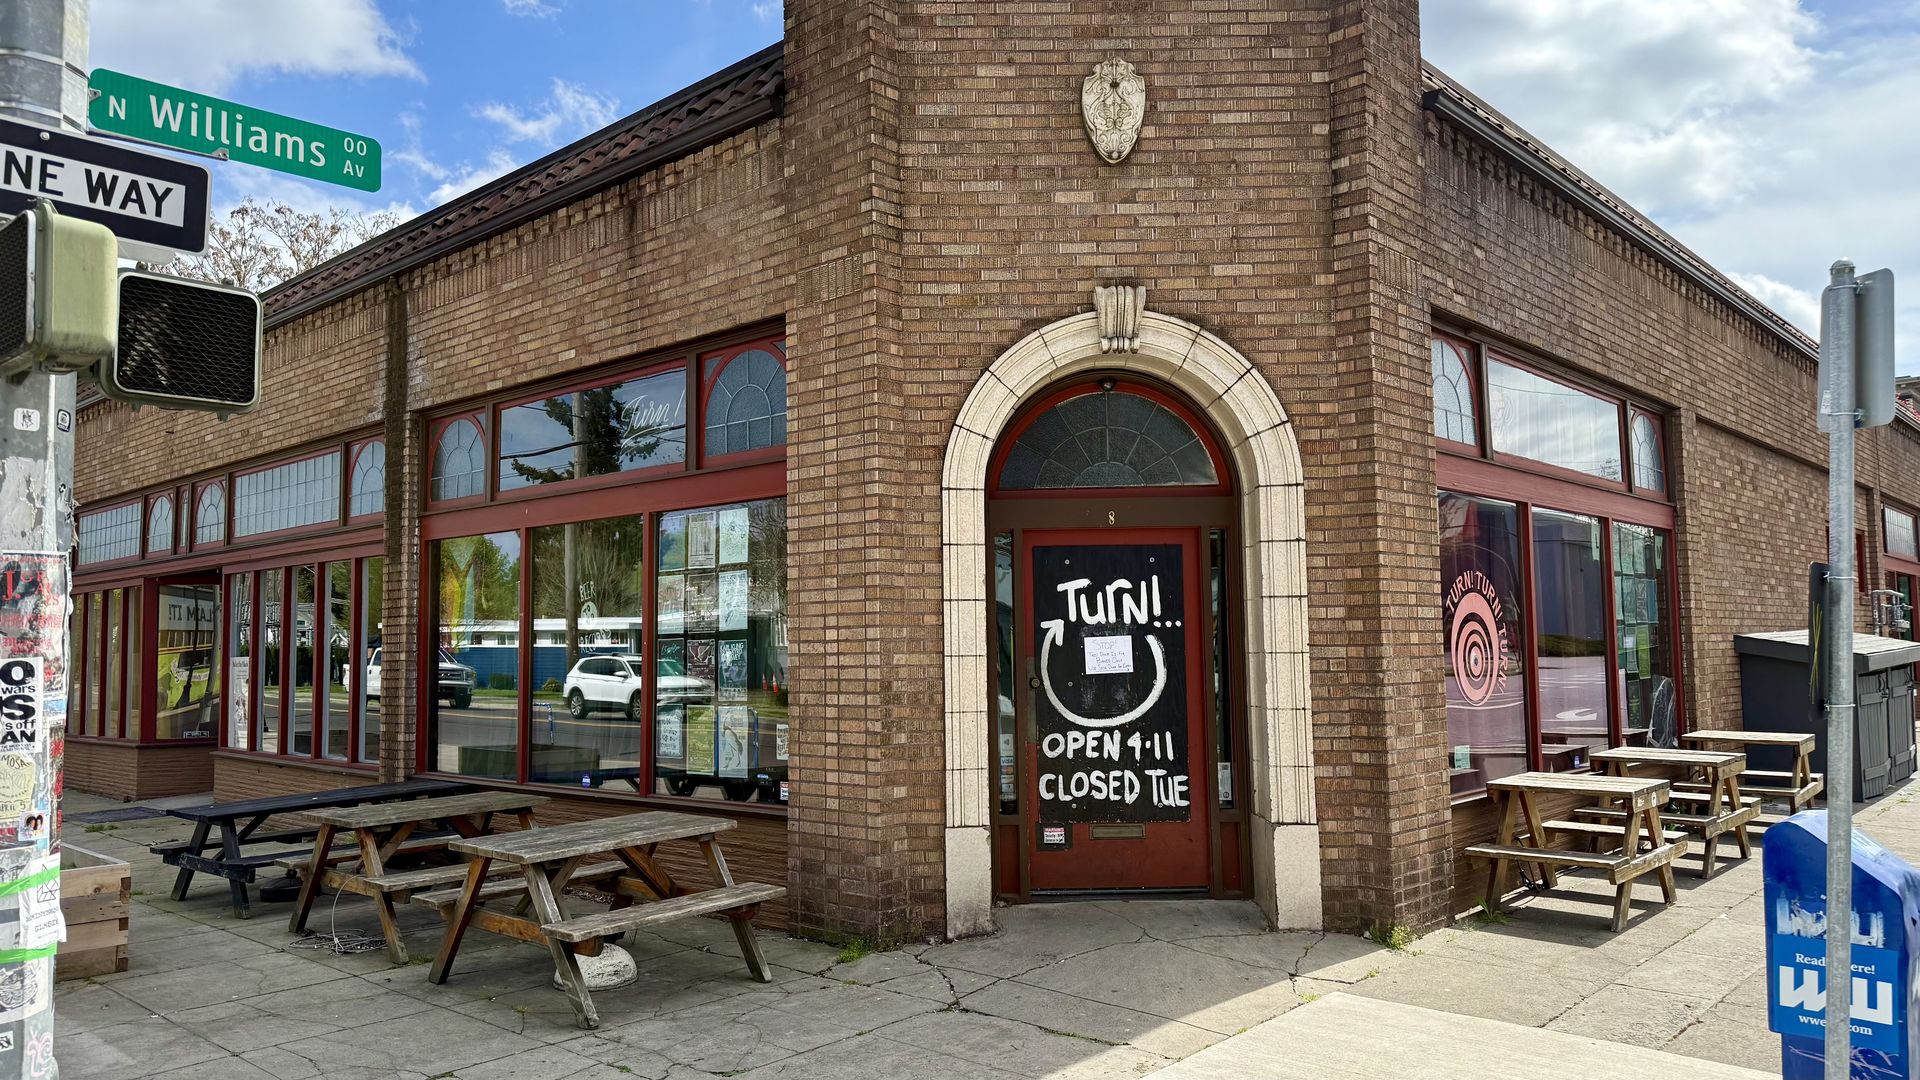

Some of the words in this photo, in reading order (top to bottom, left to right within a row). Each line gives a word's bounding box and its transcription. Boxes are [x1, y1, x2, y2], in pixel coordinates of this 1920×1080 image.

[109, 95, 126, 120] N
[150, 94, 326, 167] Williams
[3, 150, 65, 197] NE
[84, 168, 174, 218] WAY
[1108, 510, 1115, 525] 8
[580, 581, 596, 602] BEER
[1446, 569, 1474, 613] TURN!
[1475, 571, 1503, 621] TURN!
[1, 686, 35, 694] wars
[0, 695, 35, 720] S
[0, 730, 36, 745] AN
[1042, 730, 1121, 761] OPEN
[1039, 769, 1140, 804] CLOSED
[1144, 768, 1190, 807] TUE
[1795, 953, 1826, 967] Read
[1850, 964, 1876, 974] ere!
